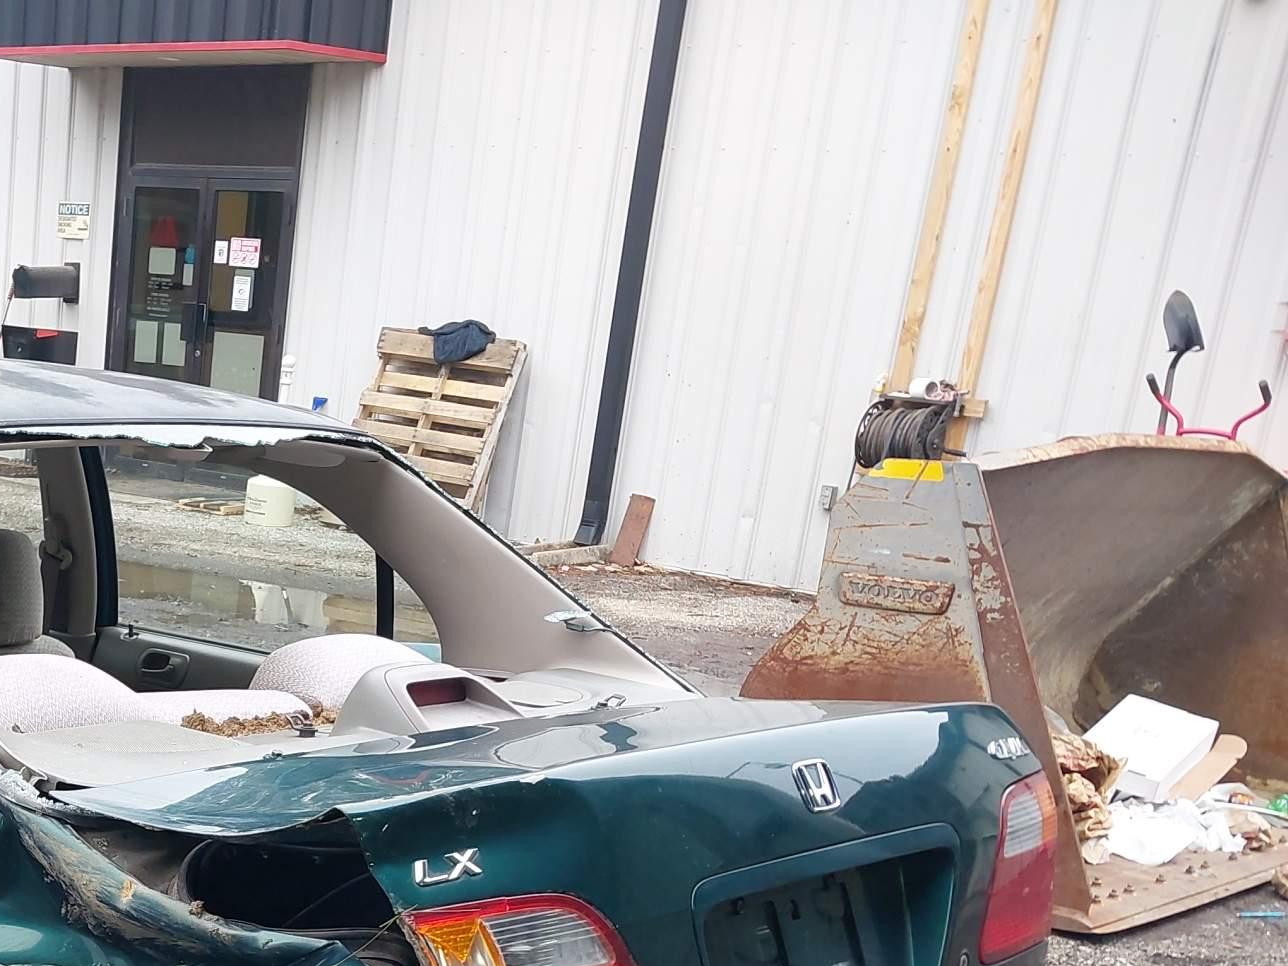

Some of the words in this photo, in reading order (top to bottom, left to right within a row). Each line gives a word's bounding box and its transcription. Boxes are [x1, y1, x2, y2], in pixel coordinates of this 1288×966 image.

[60, 204, 89, 215] NOTICE
[849, 581, 938, 605] VOLVO
[414, 848, 483, 886] LX
